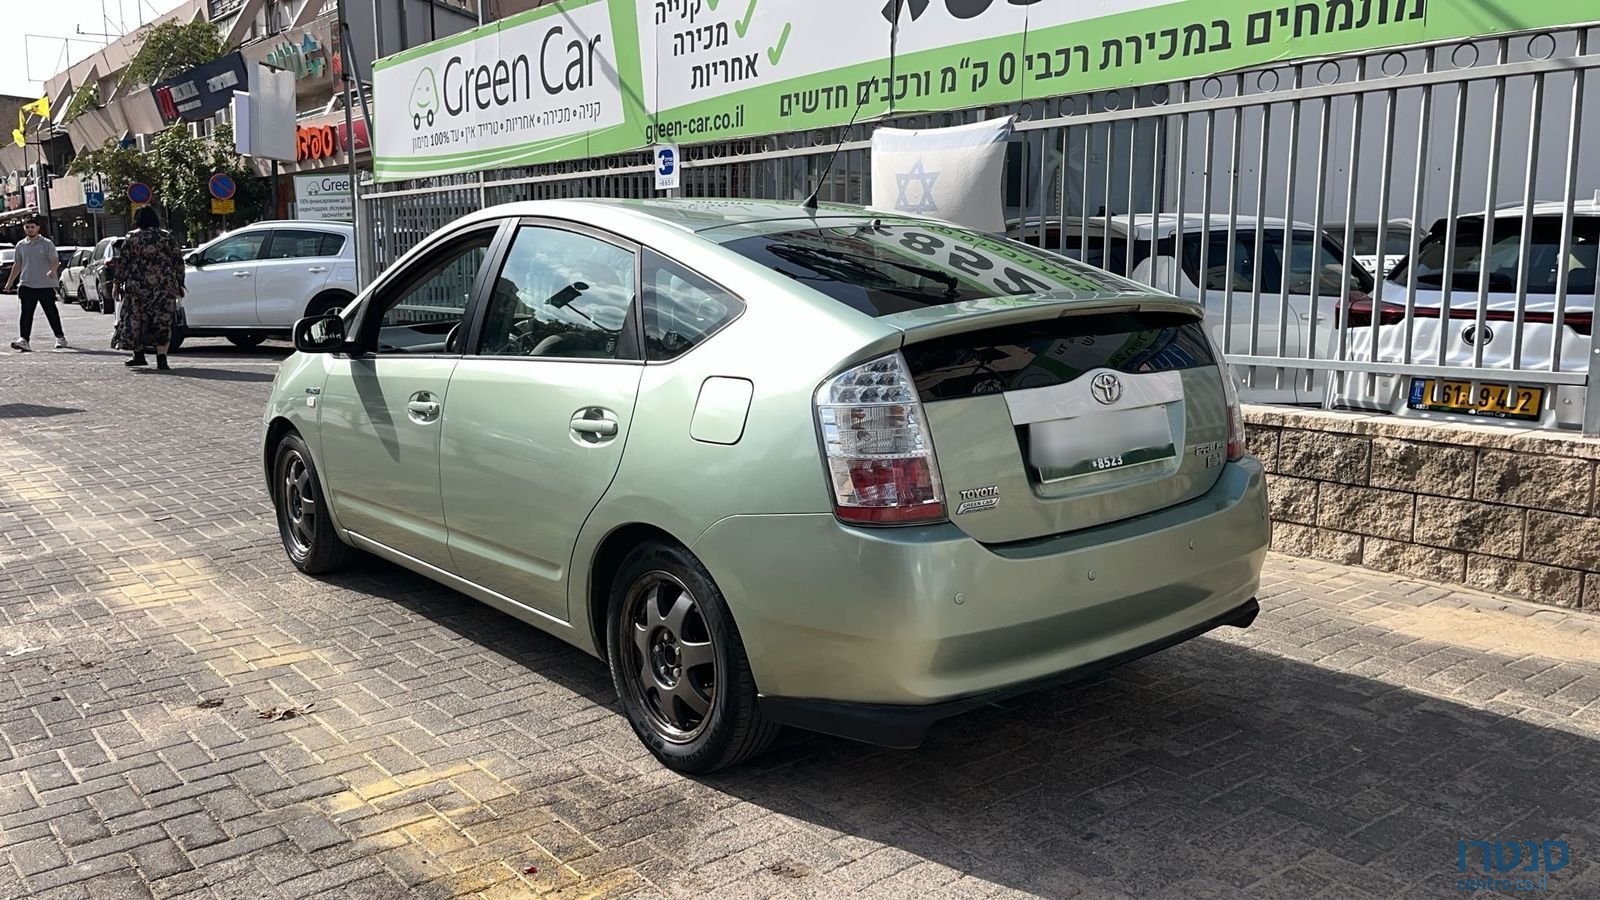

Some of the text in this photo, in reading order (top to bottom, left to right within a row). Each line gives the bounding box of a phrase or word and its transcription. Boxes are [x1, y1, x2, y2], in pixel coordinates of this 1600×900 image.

[673, 21, 729, 57] מכירה
[1100, 23, 1232, 71] במכירת
[443, 26, 602, 117] Green Car
[691, 53, 759, 90] אחריות
[1025, 45, 1089, 81] רכבי
[857, 69, 930, 106] ורכבים
[579, 101, 601, 123] קניה
[780, 84, 848, 118] חדשים
[505, 113, 536, 133] אחריות
[543, 107, 571, 126] מכירה
[646, 104, 744, 145] green-car.co.il
[430, 130, 450, 146] 100%
[450, 128, 460, 142] עד
[464, 126, 476, 144] אין
[477, 121, 499, 137] טרייד
[321, 178, 350, 192] Gree
[959, 485, 1000, 501] TOYOTA
